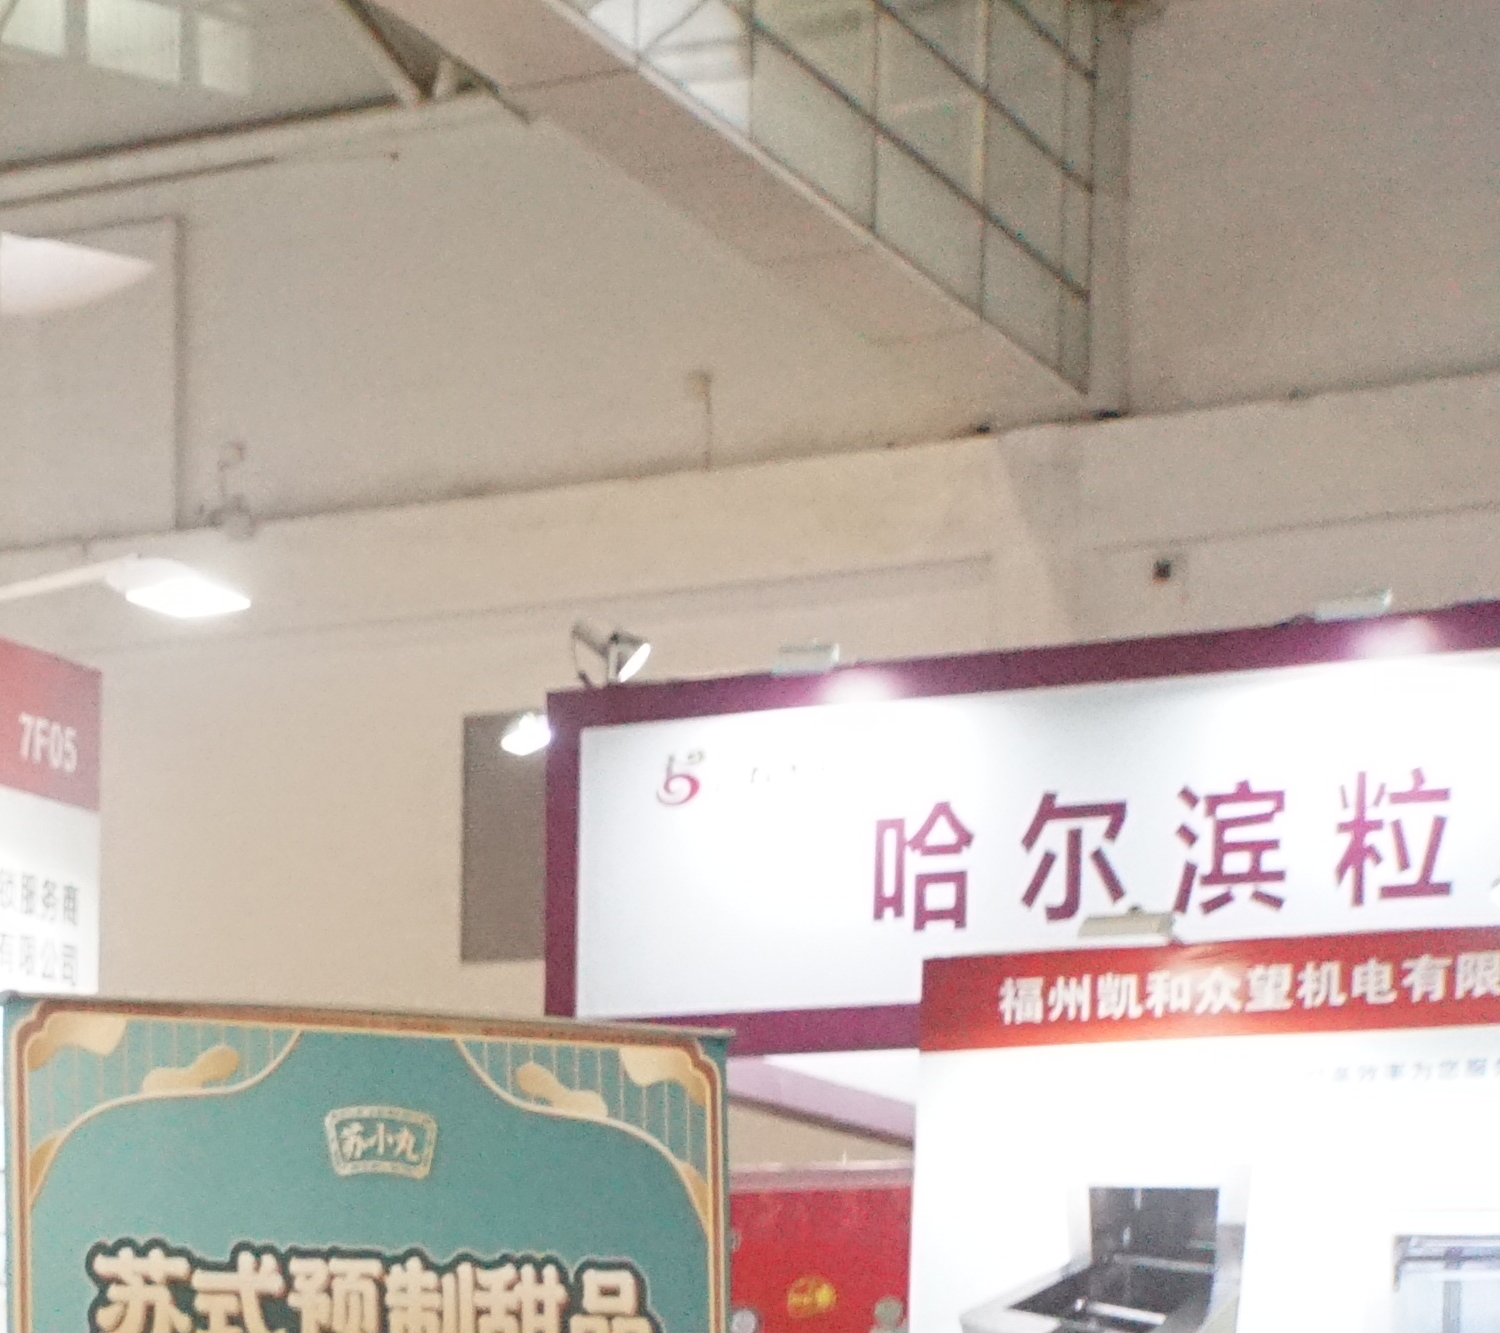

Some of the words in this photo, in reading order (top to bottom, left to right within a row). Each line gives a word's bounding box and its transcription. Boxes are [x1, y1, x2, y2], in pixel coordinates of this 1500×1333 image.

[17, 710, 79, 776] 7F05
[872, 767, 1455, 933] 哈尔滨粒
[998, 950, 1500, 1026] 福州凯和众望机电有限
[338, 1121, 422, 1164] 苏小丸
